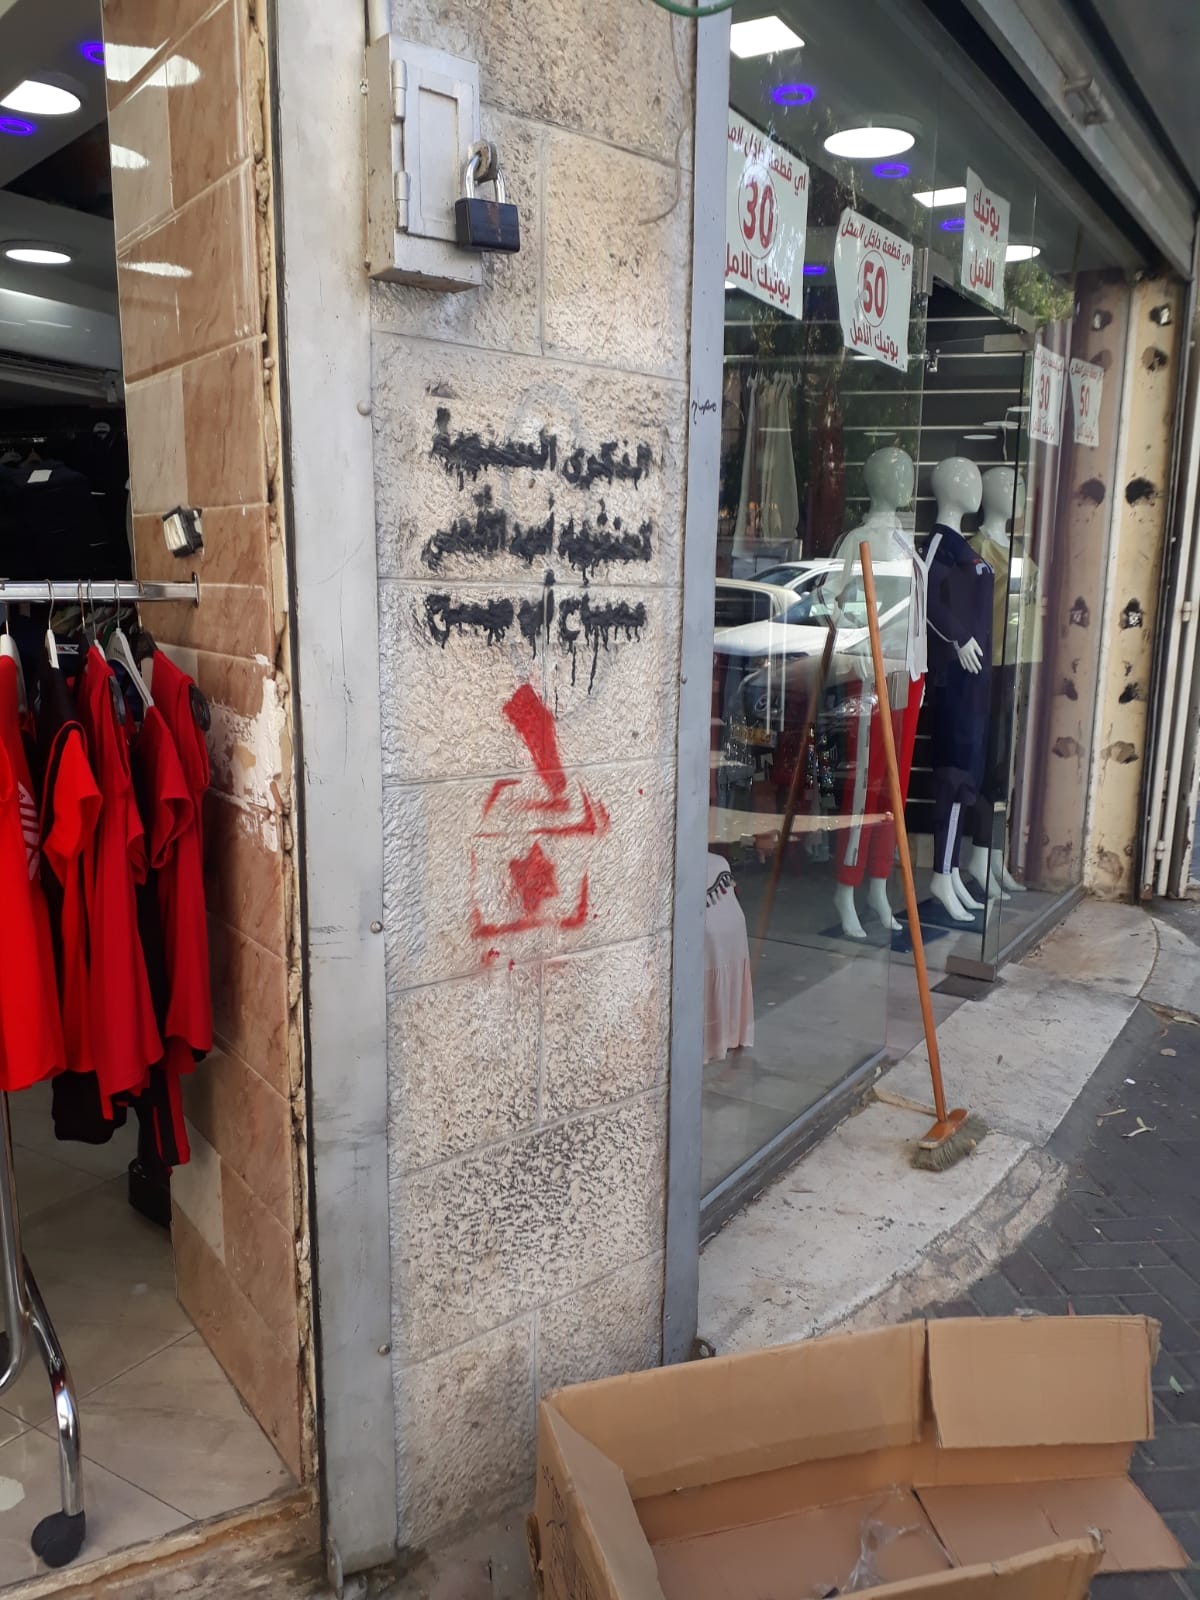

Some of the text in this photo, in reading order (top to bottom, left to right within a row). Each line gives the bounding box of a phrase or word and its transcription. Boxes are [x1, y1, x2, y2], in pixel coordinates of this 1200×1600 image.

[743, 177, 774, 249] 30
[973, 188, 1000, 242] بوتيك
[757, 263, 790, 309] بوتيك
[863, 260, 886, 318] 50
[874, 329, 899, 364] بوتيك
[1039, 374, 1050, 411] 30
[1079, 385, 1090, 417] 50
